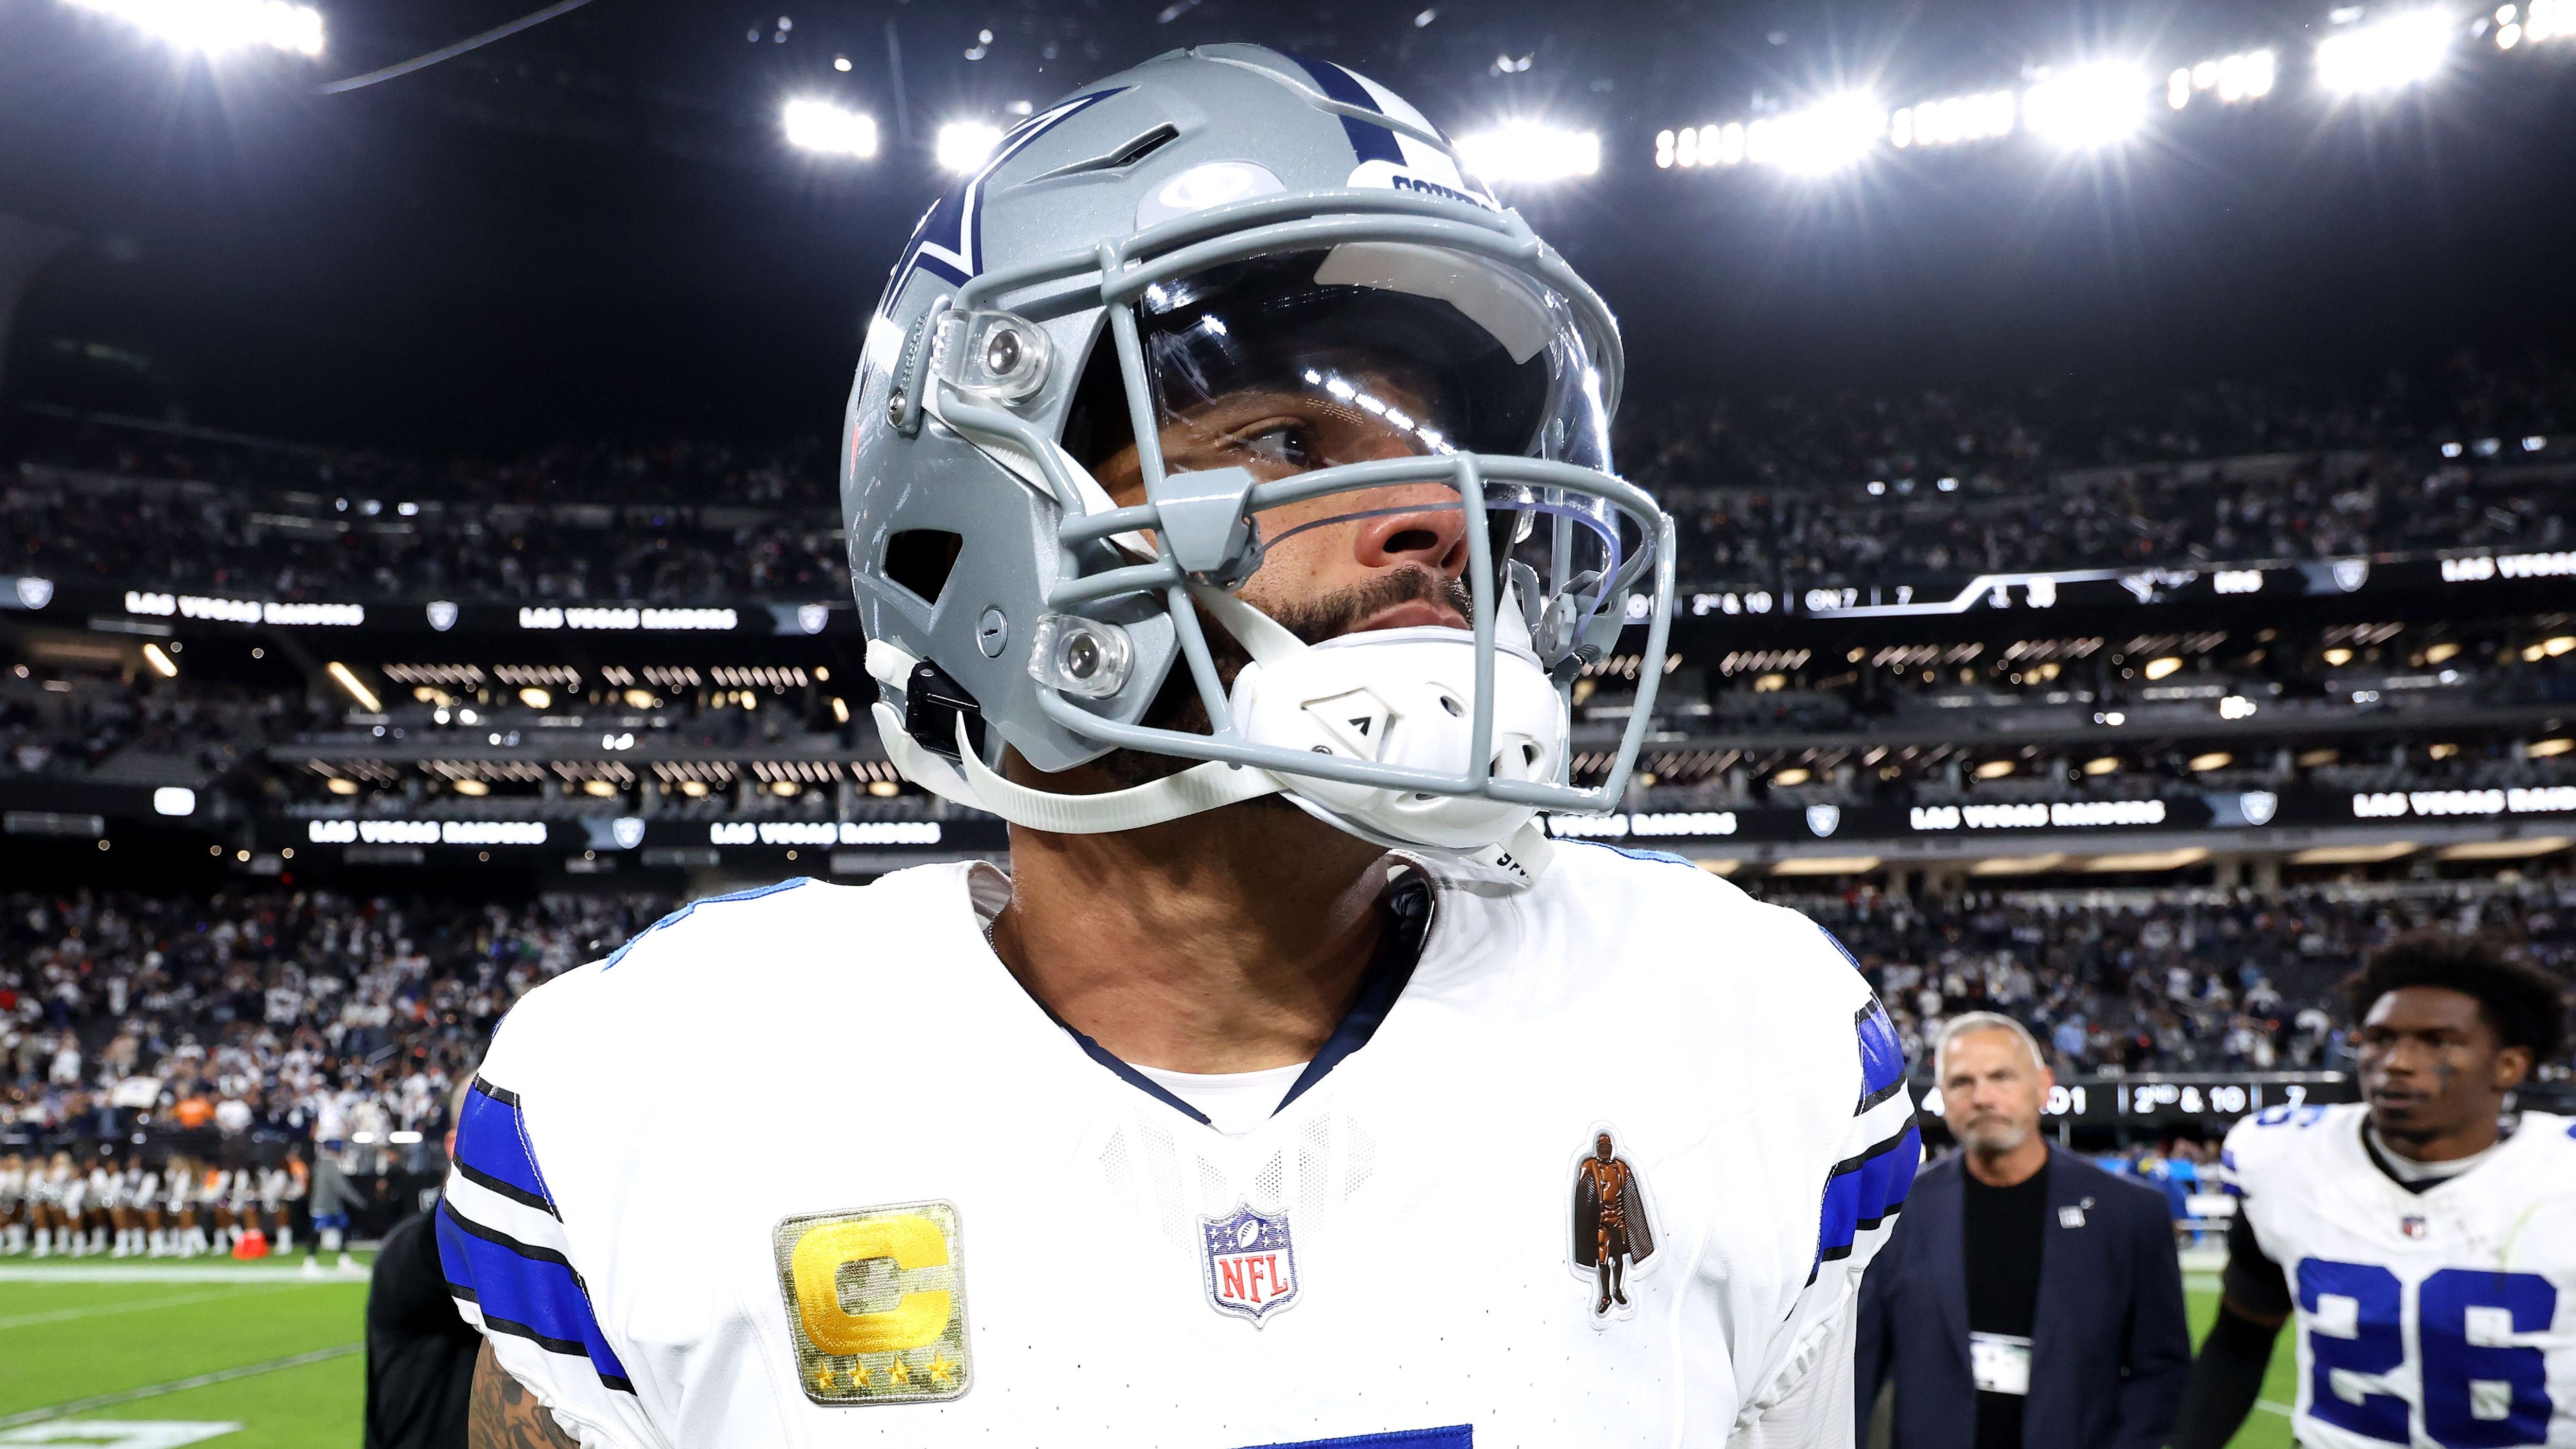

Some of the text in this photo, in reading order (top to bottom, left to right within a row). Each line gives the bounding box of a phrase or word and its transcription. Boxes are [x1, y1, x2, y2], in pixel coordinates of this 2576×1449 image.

[2209, 1086, 2246, 1113] 10
[791, 1214, 951, 1355] C
[1219, 1254, 1288, 1303] NFL
[2296, 1257, 2557, 1449] 26
